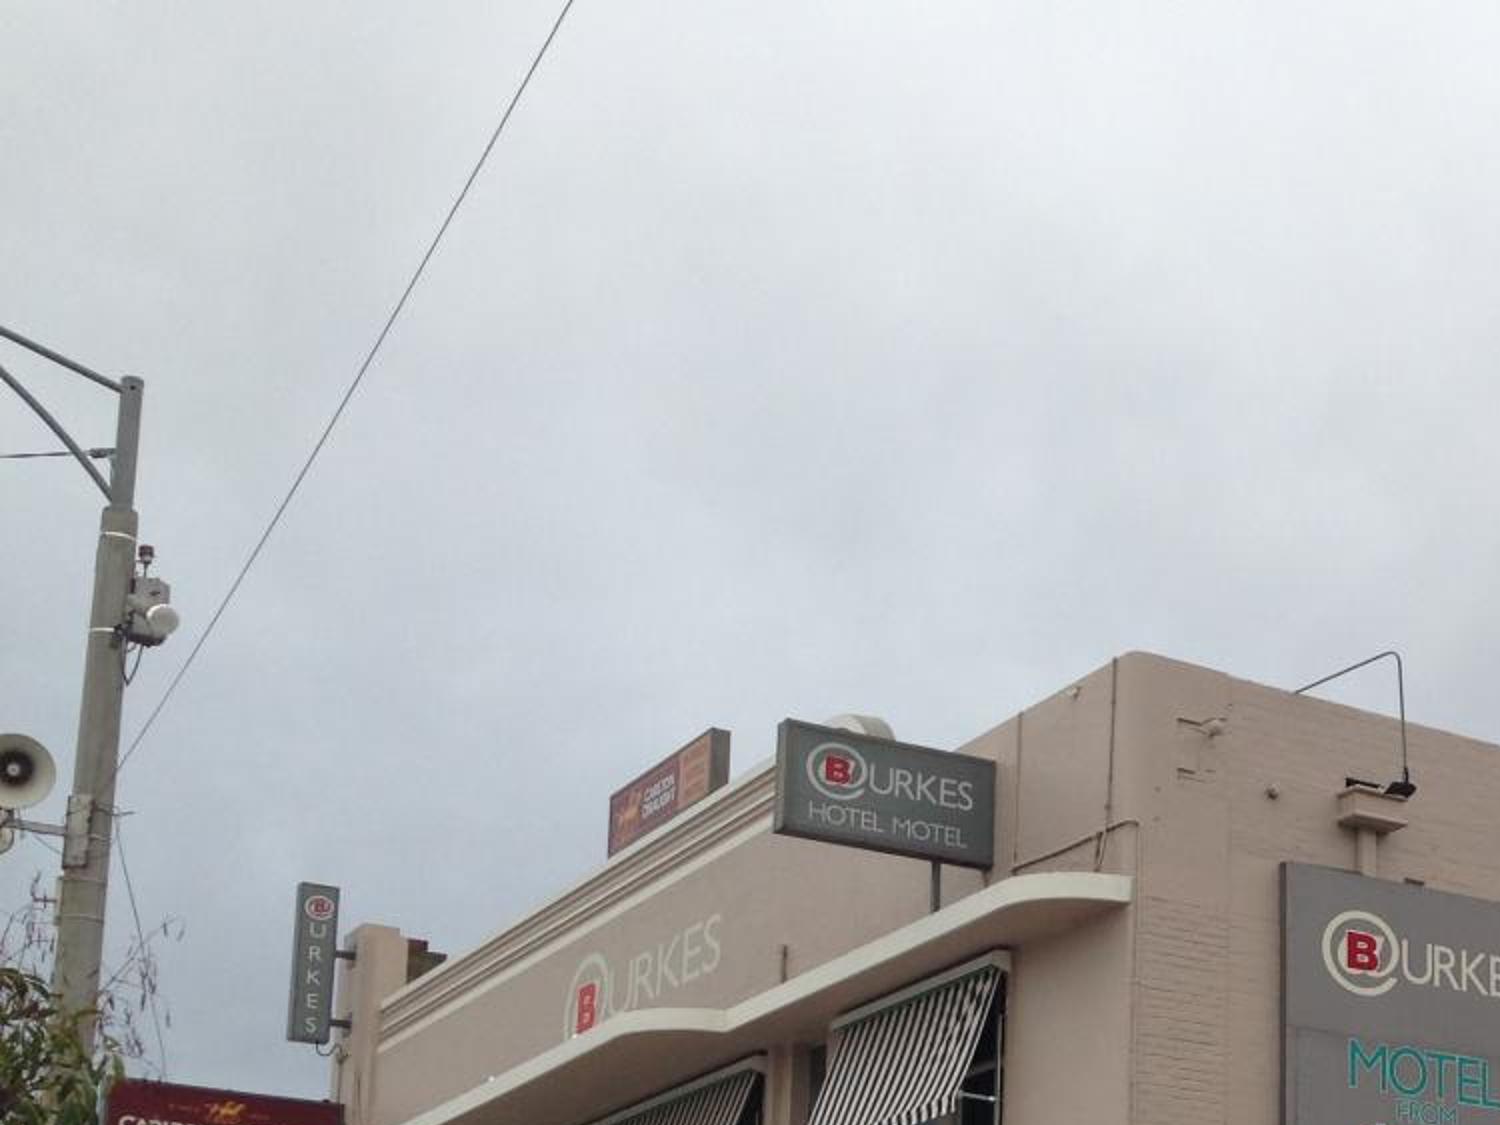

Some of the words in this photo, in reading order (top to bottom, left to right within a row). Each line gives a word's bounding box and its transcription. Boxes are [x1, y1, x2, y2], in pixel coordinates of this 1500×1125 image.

[806, 741, 973, 811] BURKES
[809, 801, 884, 833] HOTEL
[892, 816, 968, 849] MOTEL
